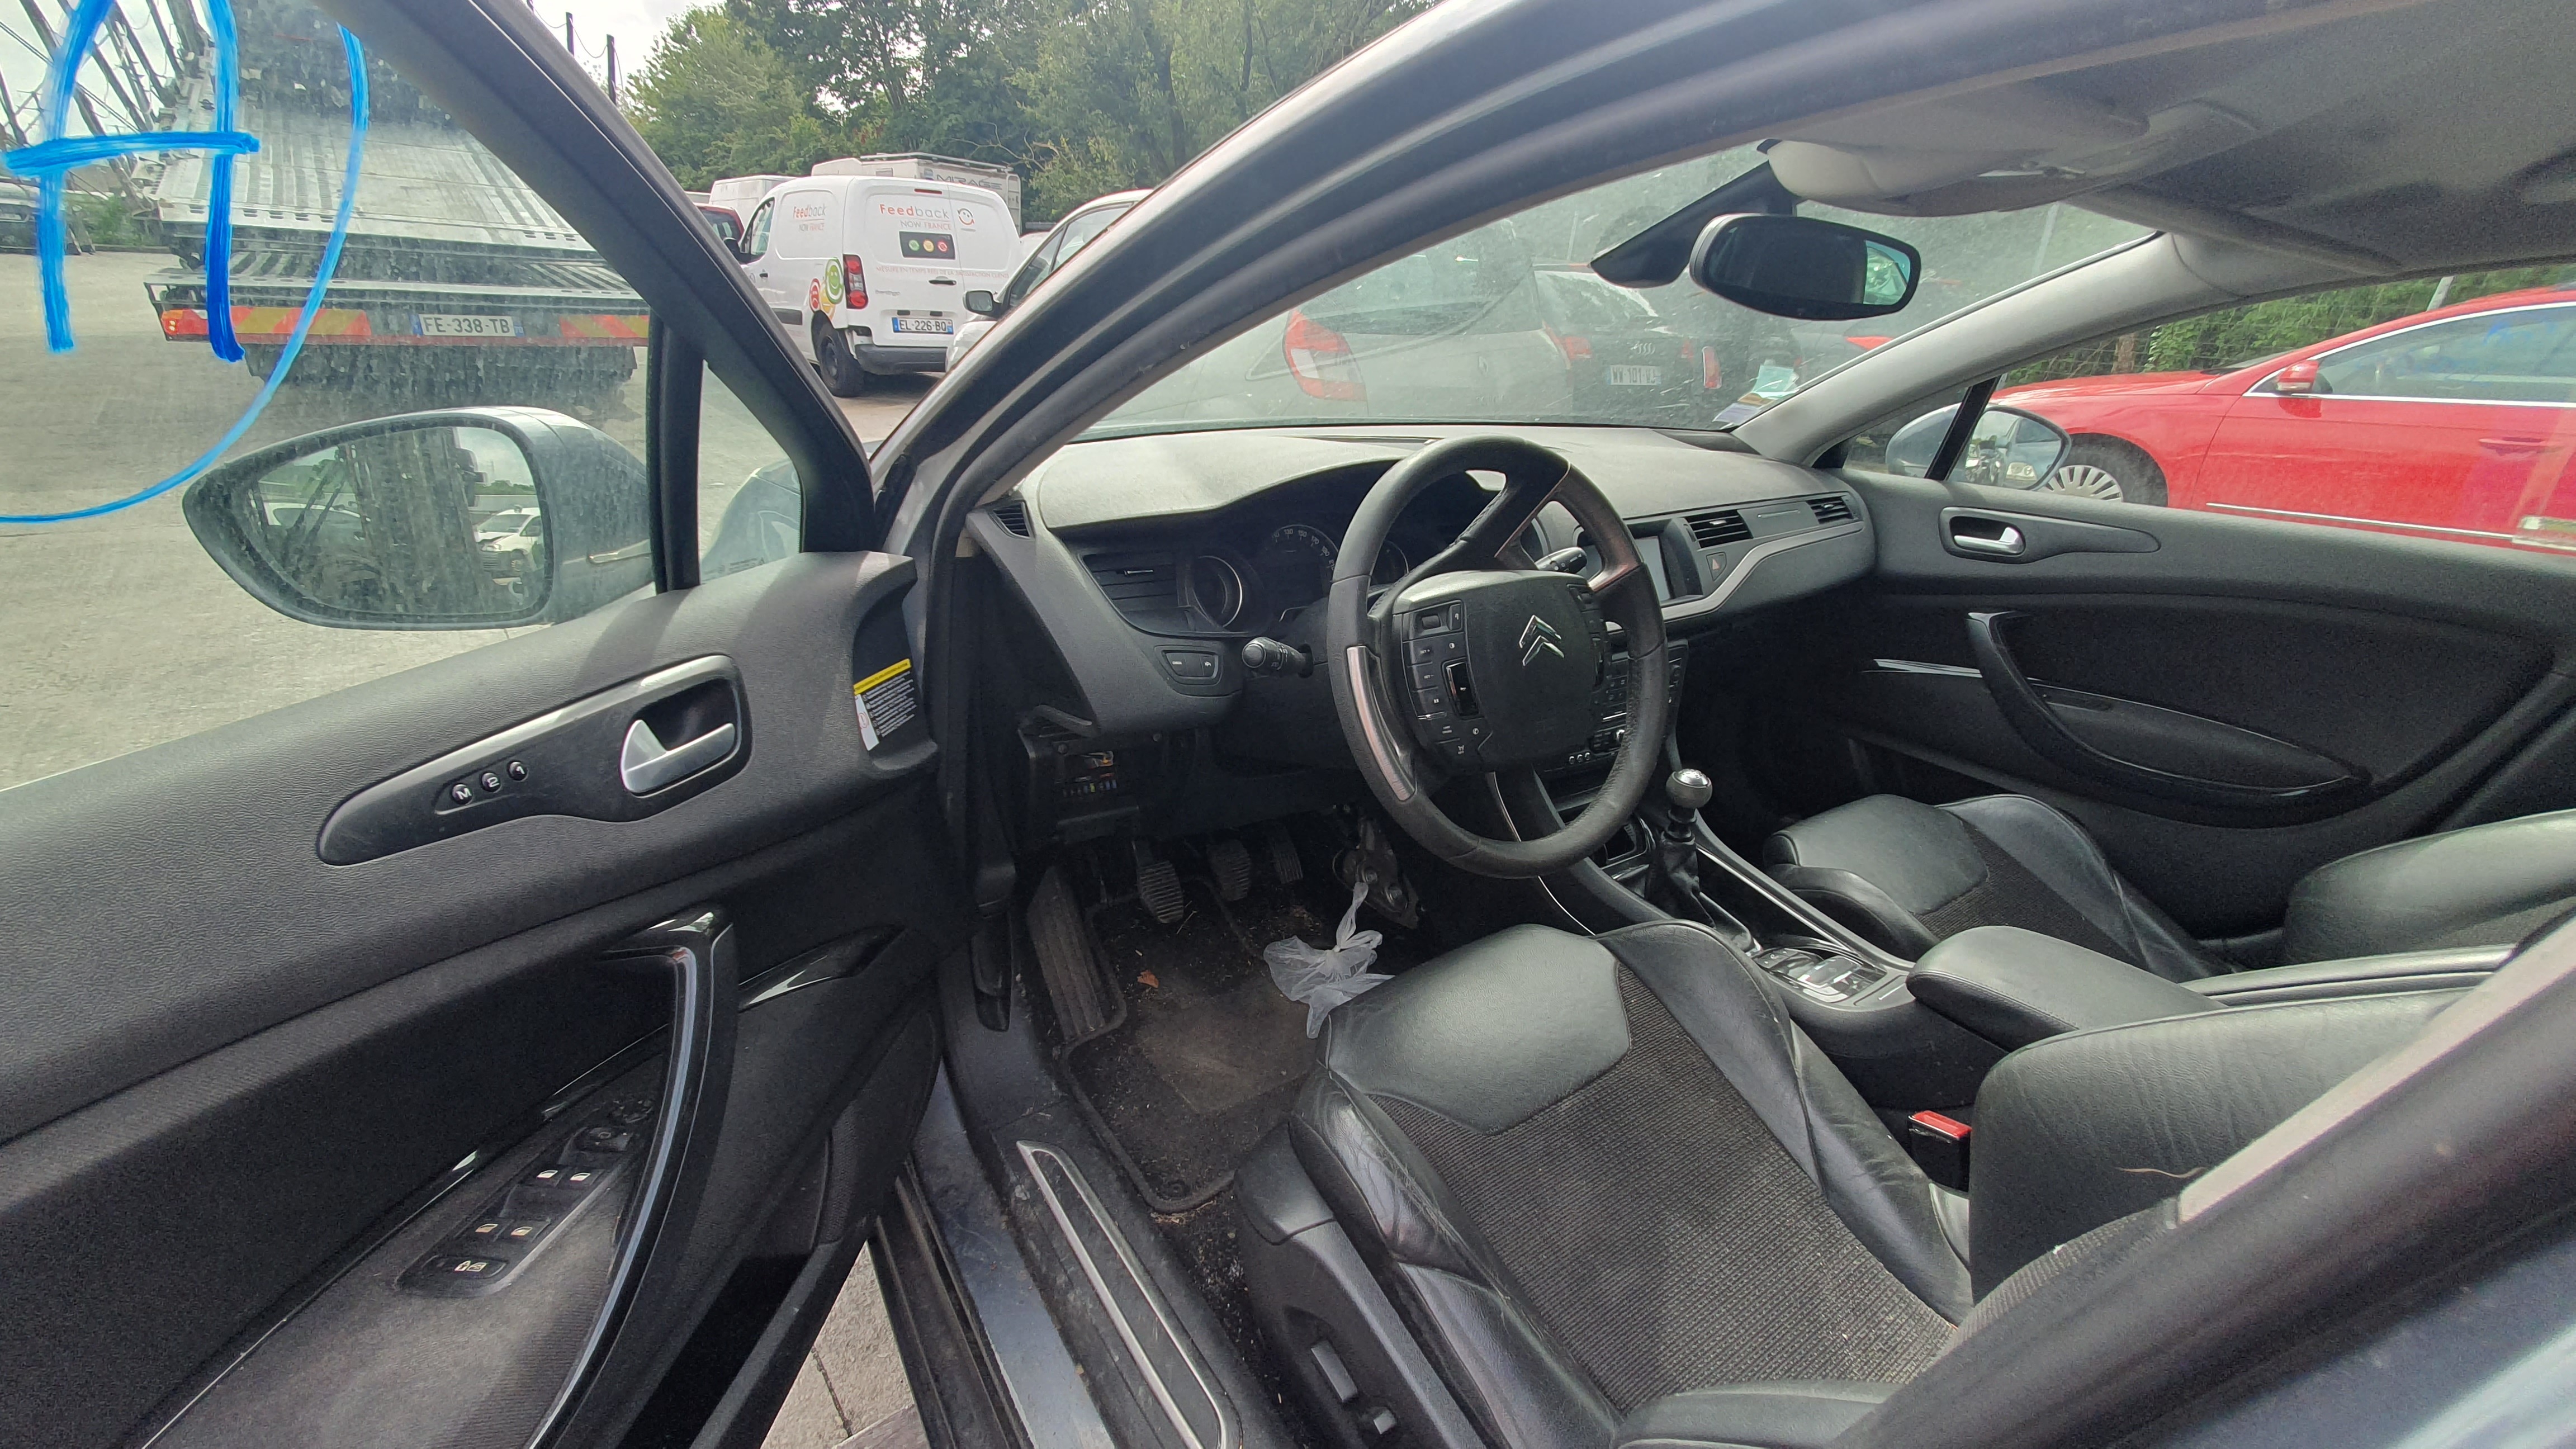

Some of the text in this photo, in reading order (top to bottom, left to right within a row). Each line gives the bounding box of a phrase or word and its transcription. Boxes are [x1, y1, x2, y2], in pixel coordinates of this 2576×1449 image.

[936, 174, 1002, 191] MIRAGE
[793, 203, 826, 219] Feedback
[879, 203, 949, 219] Feedback
[901, 220, 951, 230] NOW FRANCE
[423, 317, 510, 334] FE-338-TB
[456, 765, 525, 800] M 2 1
